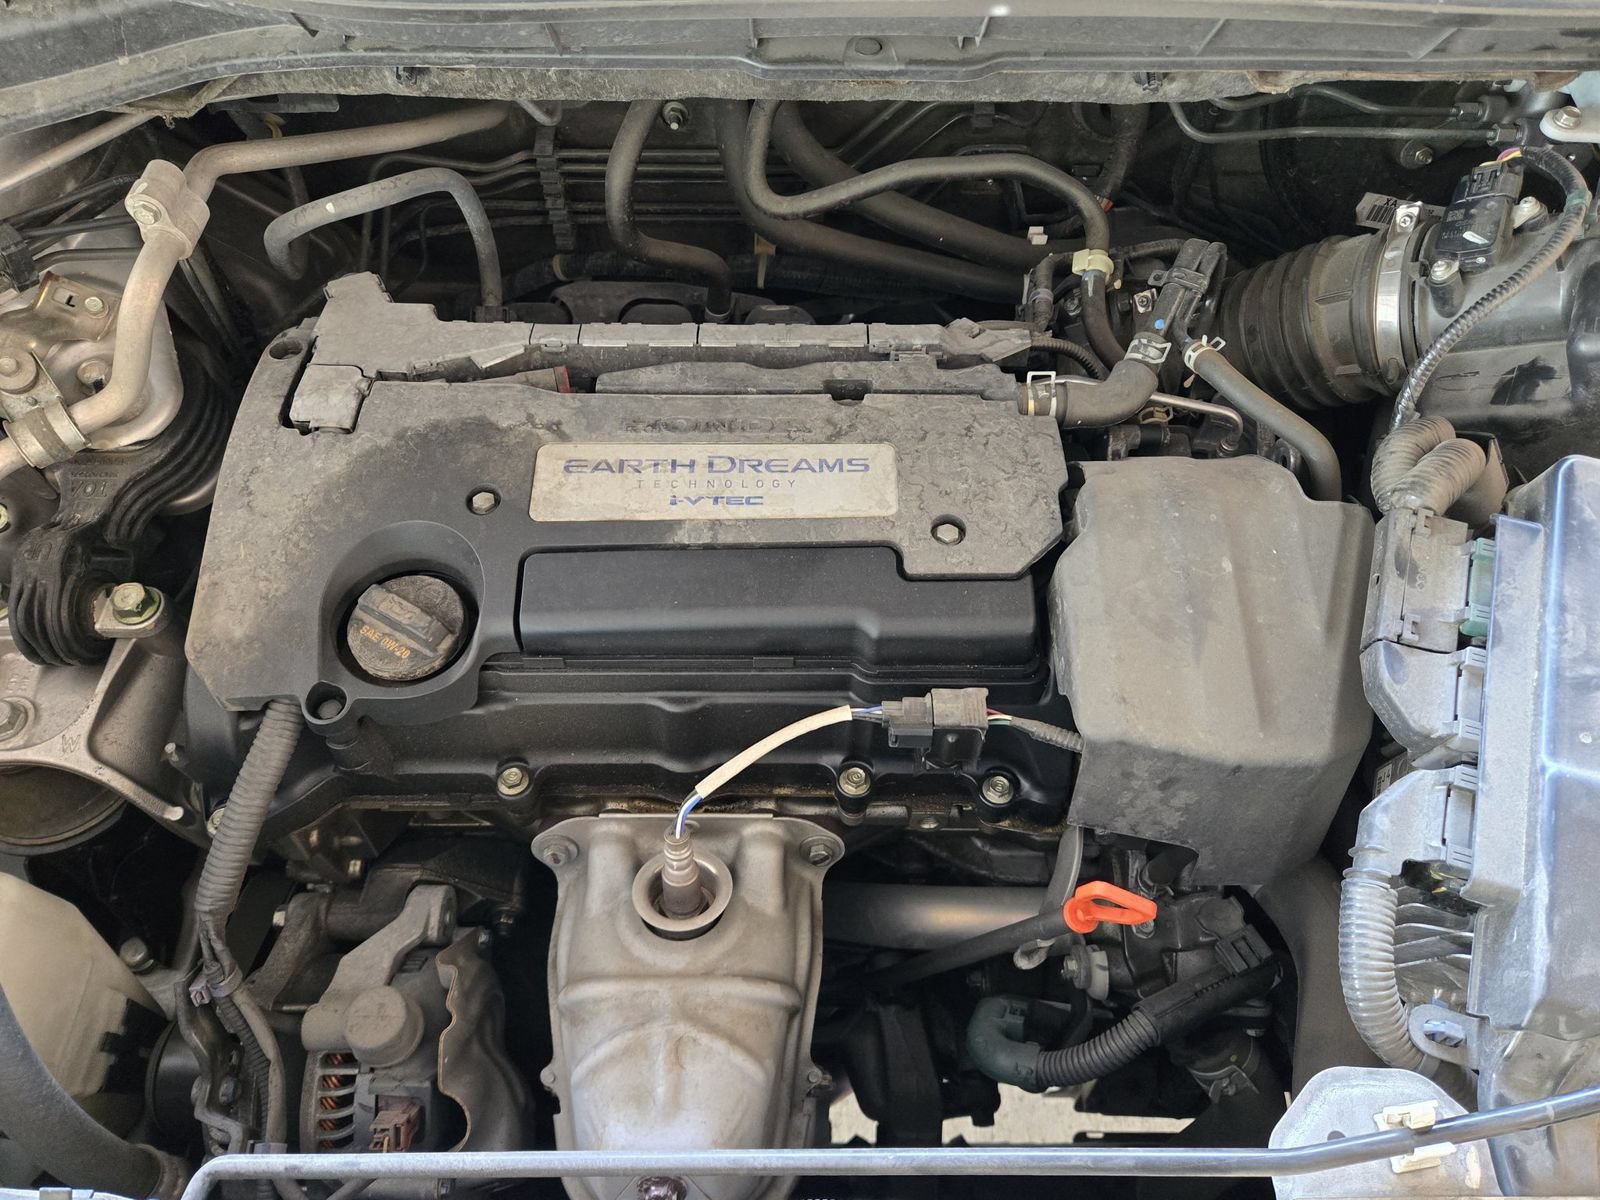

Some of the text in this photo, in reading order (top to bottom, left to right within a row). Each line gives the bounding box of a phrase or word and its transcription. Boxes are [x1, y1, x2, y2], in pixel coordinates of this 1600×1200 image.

[563, 455, 871, 474] EARTH DREAMS
[637, 479, 796, 489] TECHNOLOGY
[669, 495, 764, 506] i-VTEC
[360, 625, 382, 641] SAE
